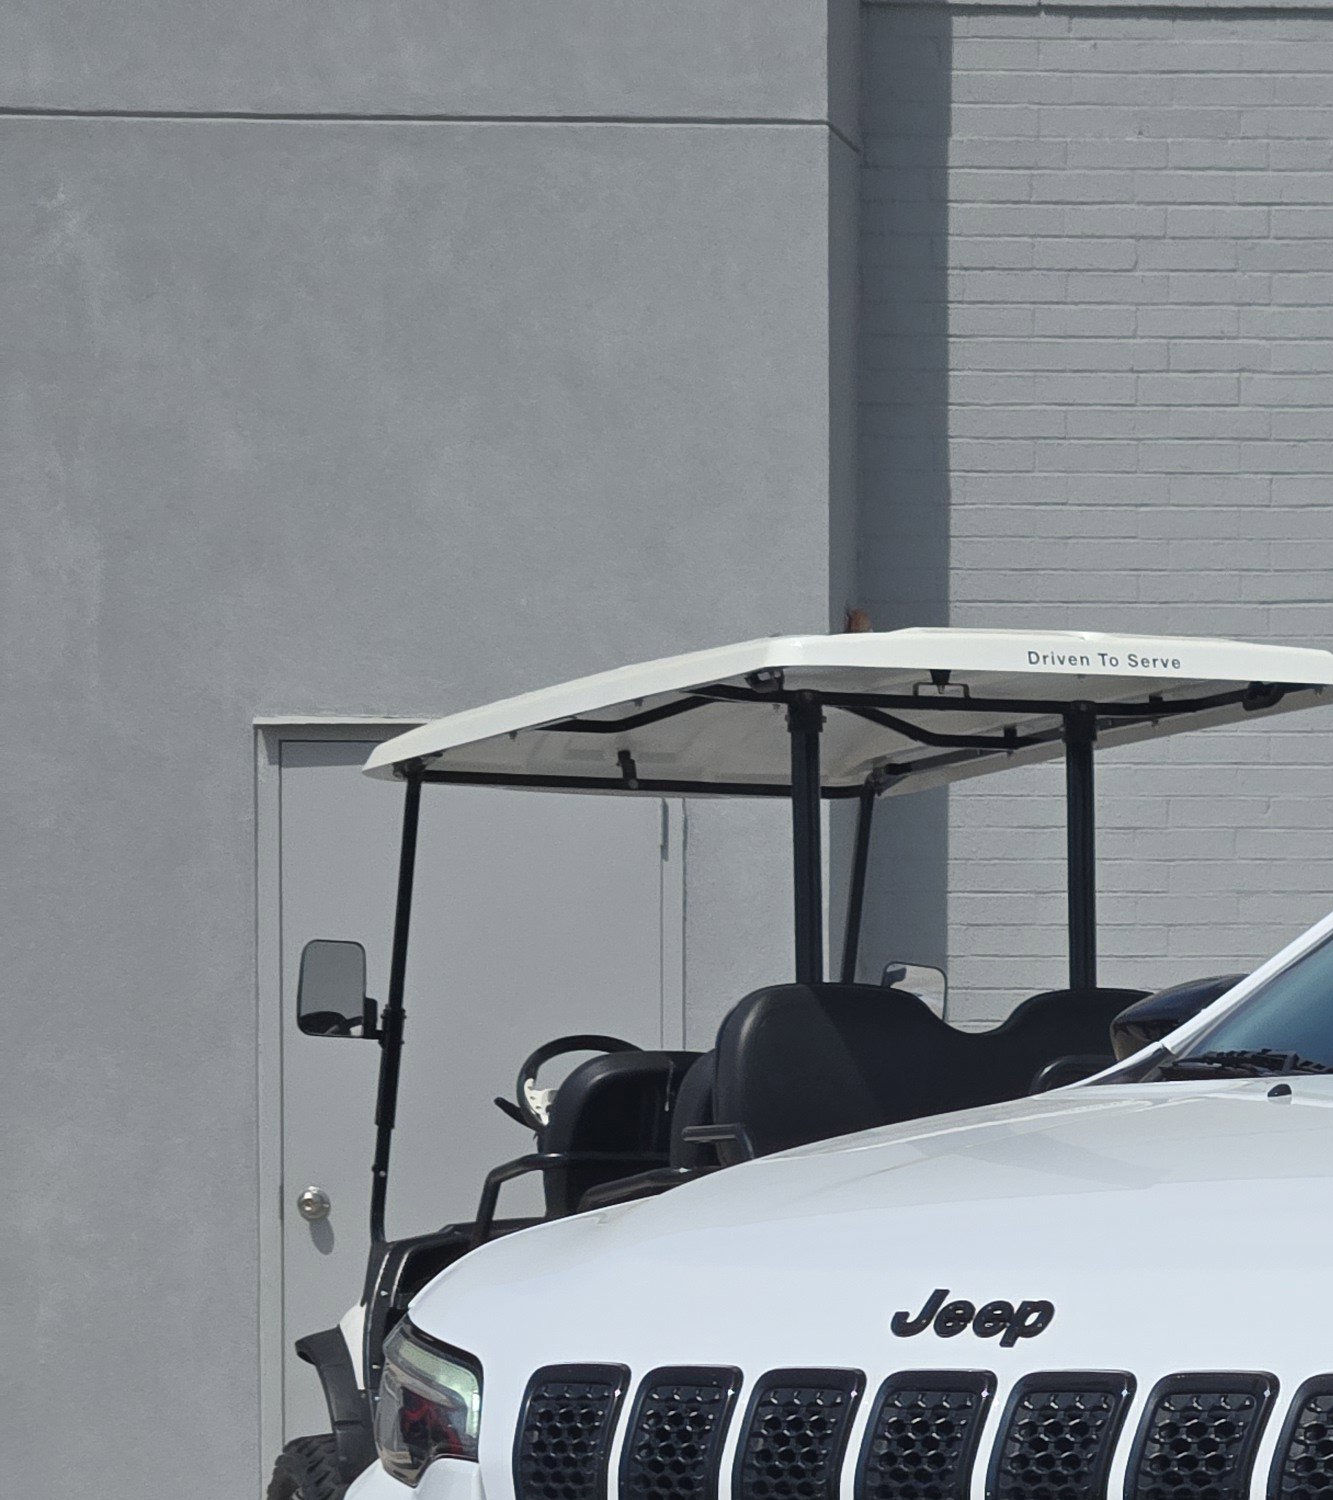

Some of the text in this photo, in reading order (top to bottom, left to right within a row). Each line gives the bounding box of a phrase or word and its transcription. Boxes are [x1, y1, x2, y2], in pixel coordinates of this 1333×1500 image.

[1027, 650, 1181, 668] Driven To Serve
[890, 1288, 1056, 1348] Jeep
